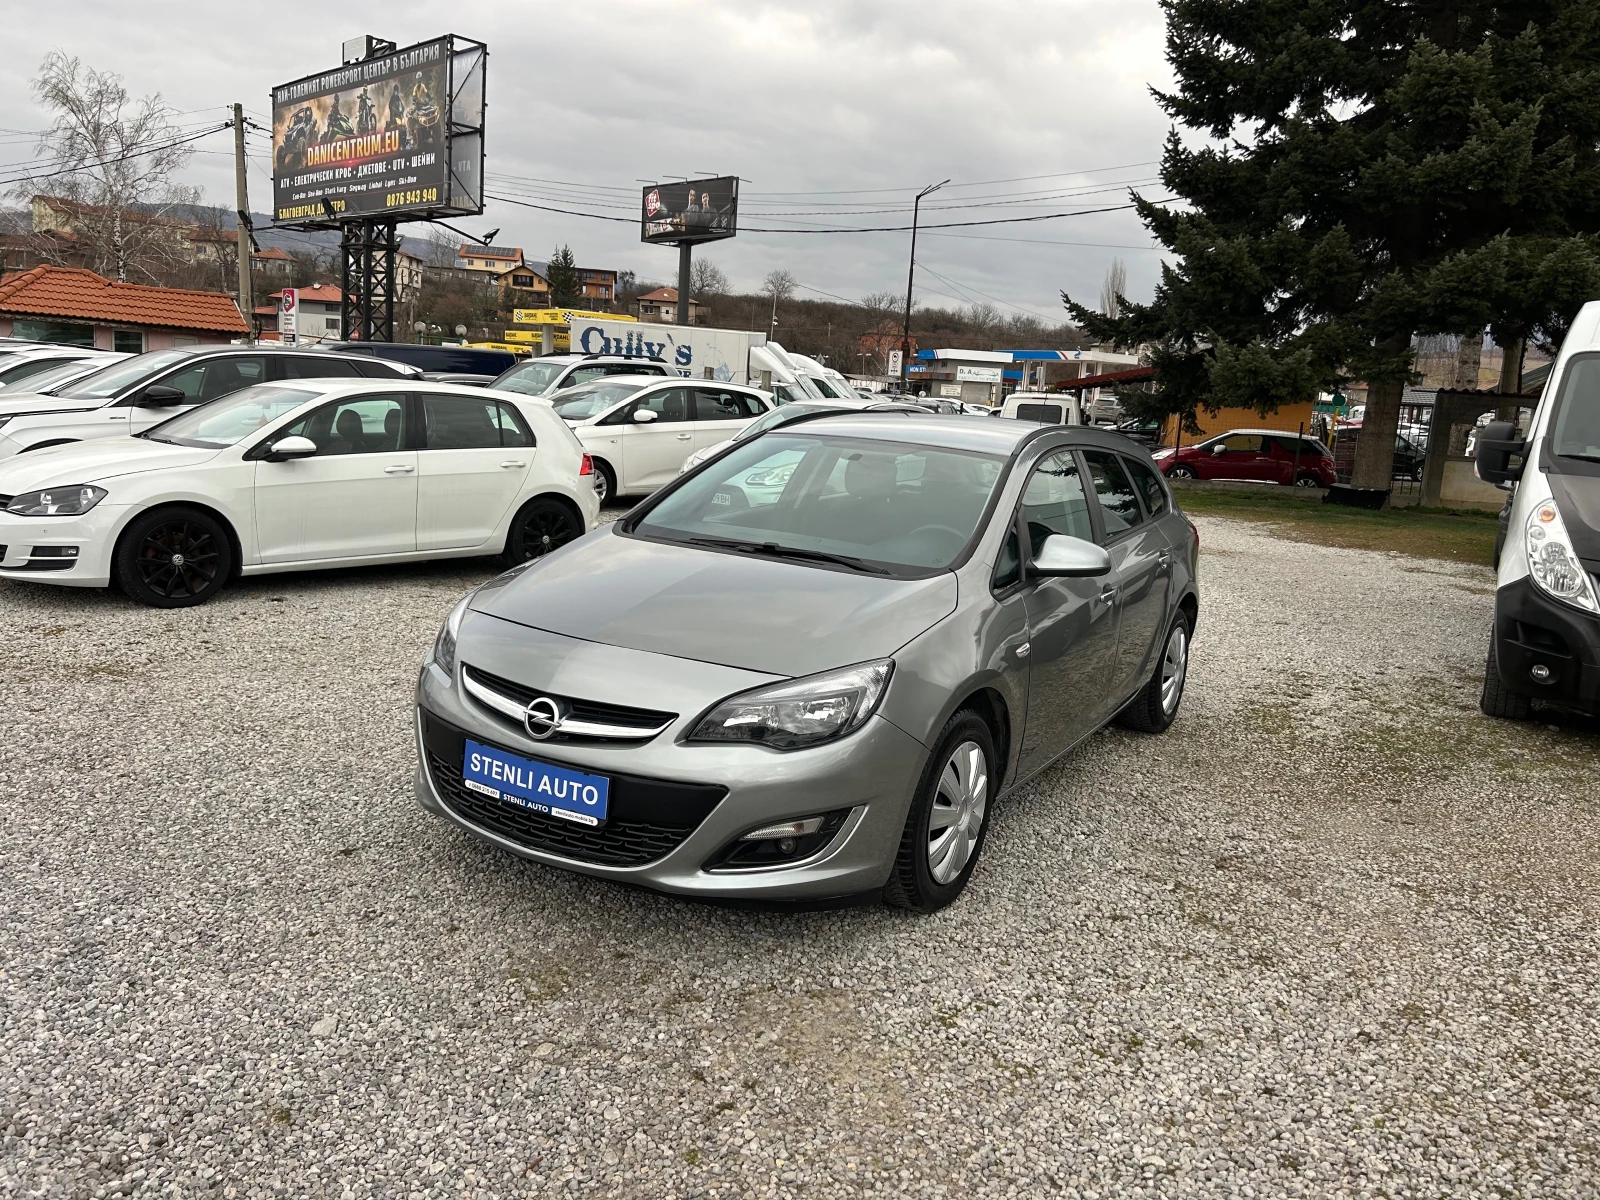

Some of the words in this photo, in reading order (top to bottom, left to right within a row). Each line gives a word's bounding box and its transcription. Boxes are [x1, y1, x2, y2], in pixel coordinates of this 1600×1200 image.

[277, 78, 319, 103] НАЙ-ГОЛЕМИЯТ
[321, 67, 361, 91] POWERSPORT
[363, 59, 391, 81] ЦЕНТЪР
[393, 57, 398, 72] В
[400, 44, 440, 70] БЪЛГАРИЯ
[307, 130, 399, 166] DANICENTRUM.EU
[280, 178, 290, 189] ATV
[294, 169, 334, 186] ЕЛЕКТРИЧЕСКИ
[335, 167, 352, 179] КРОС
[357, 161, 387, 178] ДЖЕТОВЕ
[392, 158, 405, 171] UTV
[411, 152, 436, 168] ШЕЙНИ
[278, 203, 315, 220] БЛАГОЕВГРАД
[386, 192, 405, 207] 0876
[406, 190, 420, 204] 943
[422, 188, 437, 202] 940
[470, 752, 533, 790] STENLI
[537, 774, 599, 805] AUTO
[503, 793, 526, 807] STENLI
[527, 801, 549, 813] AUTO
